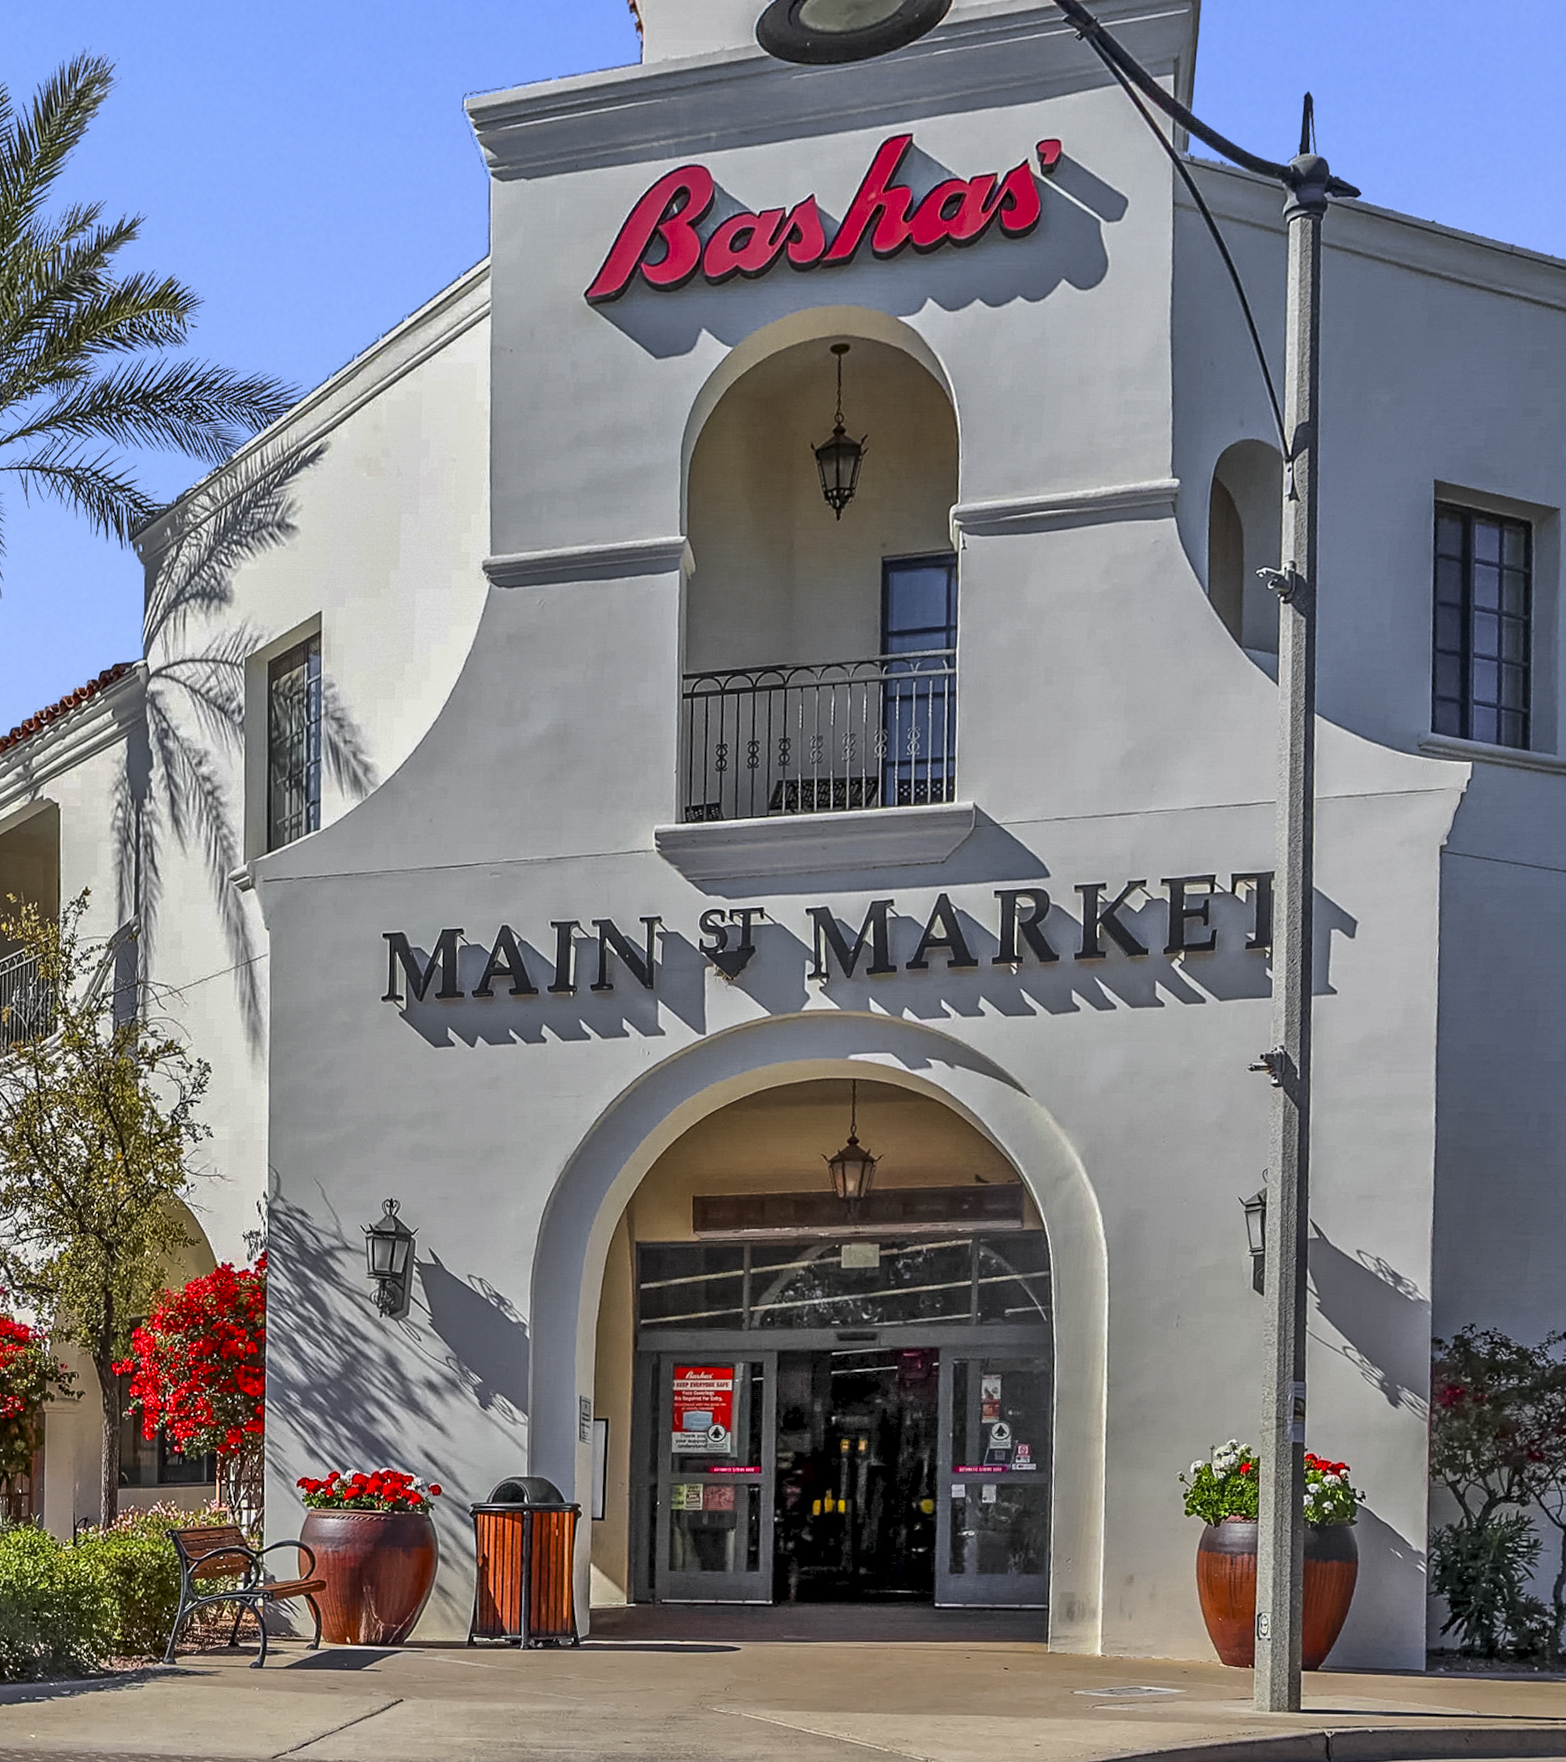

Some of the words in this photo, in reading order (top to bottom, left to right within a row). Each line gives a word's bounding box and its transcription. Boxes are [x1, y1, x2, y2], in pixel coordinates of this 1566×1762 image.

[584, 133, 1061, 303] Bashas'
[381, 915, 662, 1001] MAIN
[698, 906, 765, 955] ST
[806, 871, 1275, 980] MARKET
